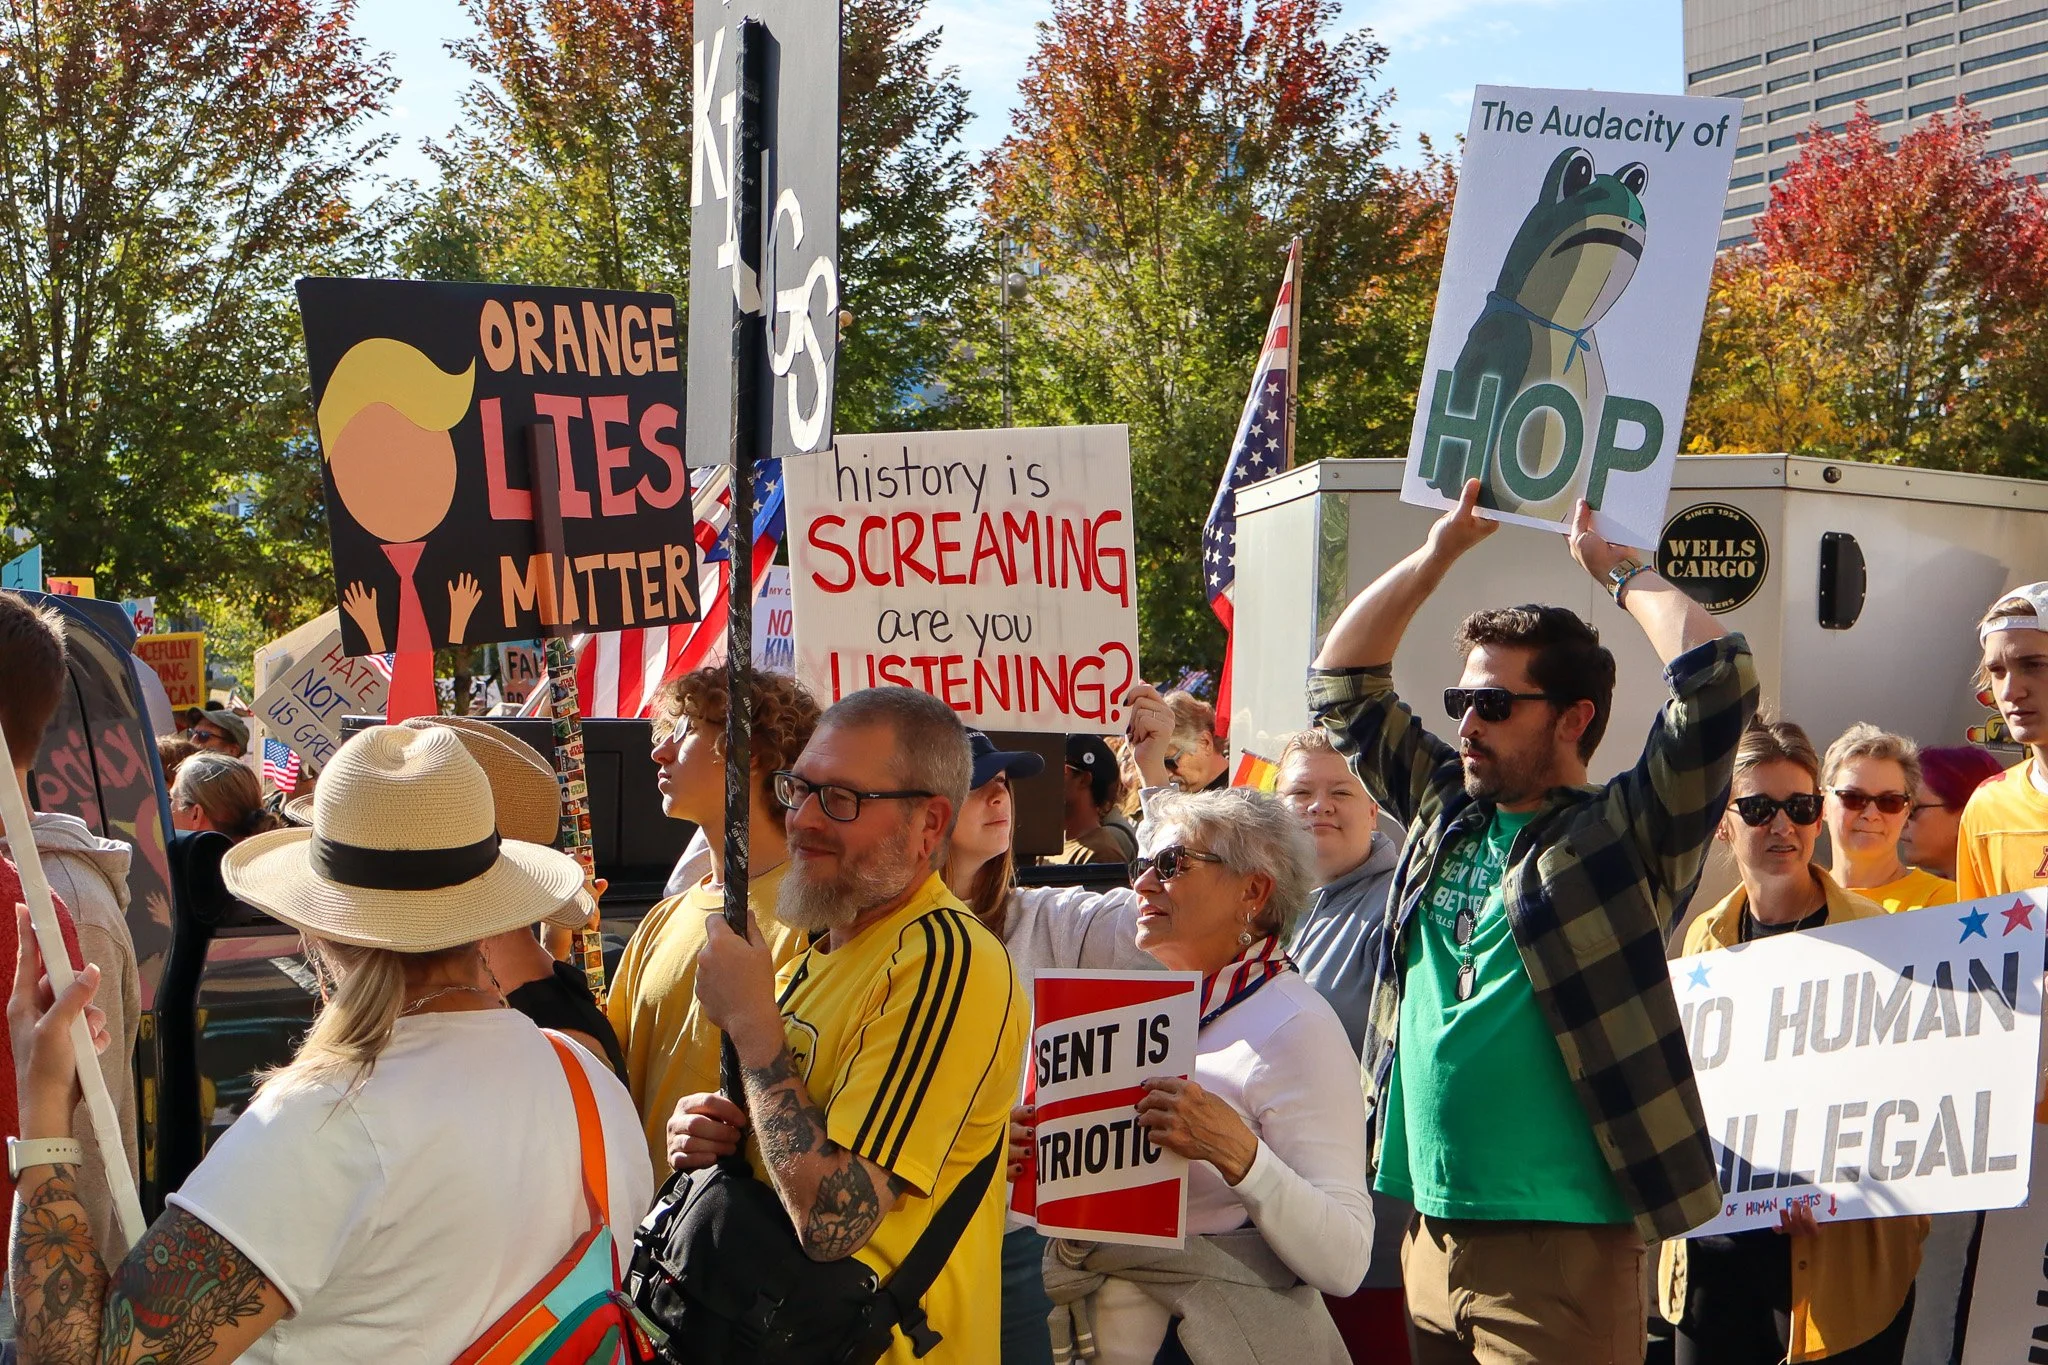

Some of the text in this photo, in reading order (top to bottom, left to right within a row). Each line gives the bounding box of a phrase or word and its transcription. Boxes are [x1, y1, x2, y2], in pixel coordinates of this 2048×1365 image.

[1480, 101, 1731, 152] The Audacity of
[479, 299, 678, 377] ORANGE
[479, 393, 686, 520] LIES
[1418, 369, 1665, 512] HOP
[834, 443, 1051, 514] history is
[1684, 508, 1741, 521] SINCE 1954
[807, 510, 1129, 608] SCREAMING
[1667, 560, 1756, 578] CARGO
[1668, 539, 1756, 557] WELLS
[877, 609, 1033, 658] are you
[291, 667, 352, 718] NOT
[321, 643, 381, 703] HATE
[267, 696, 299, 726] US
[1764, 952, 2020, 1062] HUMAN
[1035, 1013, 1171, 1091] SENT IS
[1719, 1090, 2018, 1195] ILLEGAL
[1725, 1203, 1739, 1217] OF
[1746, 1197, 1778, 1217] HUMAN
